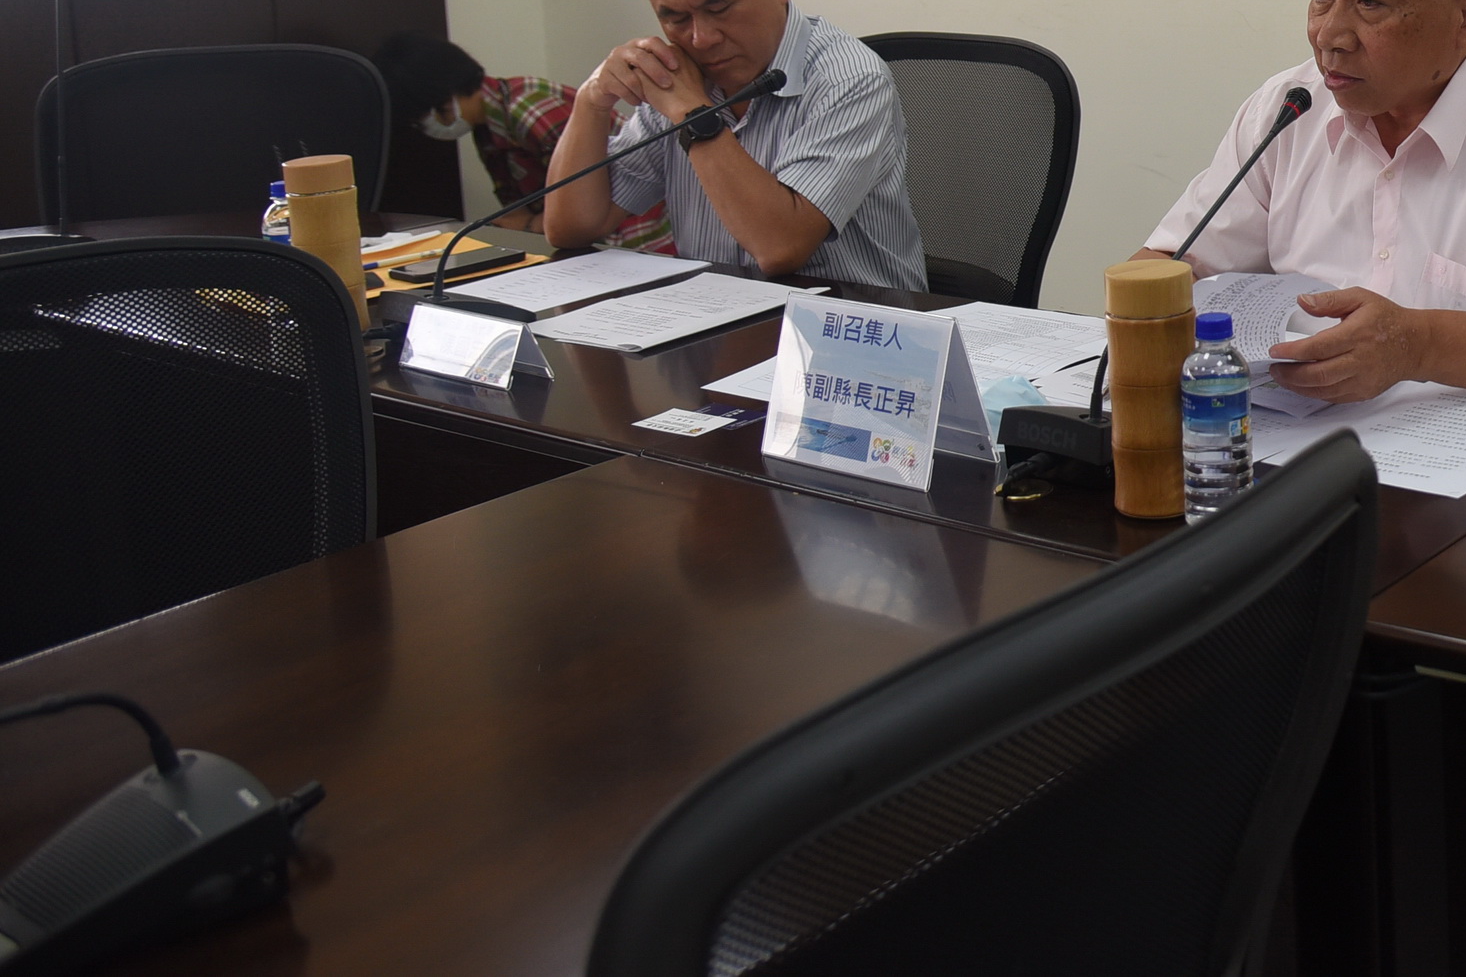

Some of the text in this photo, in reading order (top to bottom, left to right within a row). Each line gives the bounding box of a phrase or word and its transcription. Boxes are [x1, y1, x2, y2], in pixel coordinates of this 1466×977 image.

[823, 311, 903, 351] 副召集人
[793, 370, 916, 419] 陳副縣長正昇
[1017, 421, 1078, 449] BOSCH
